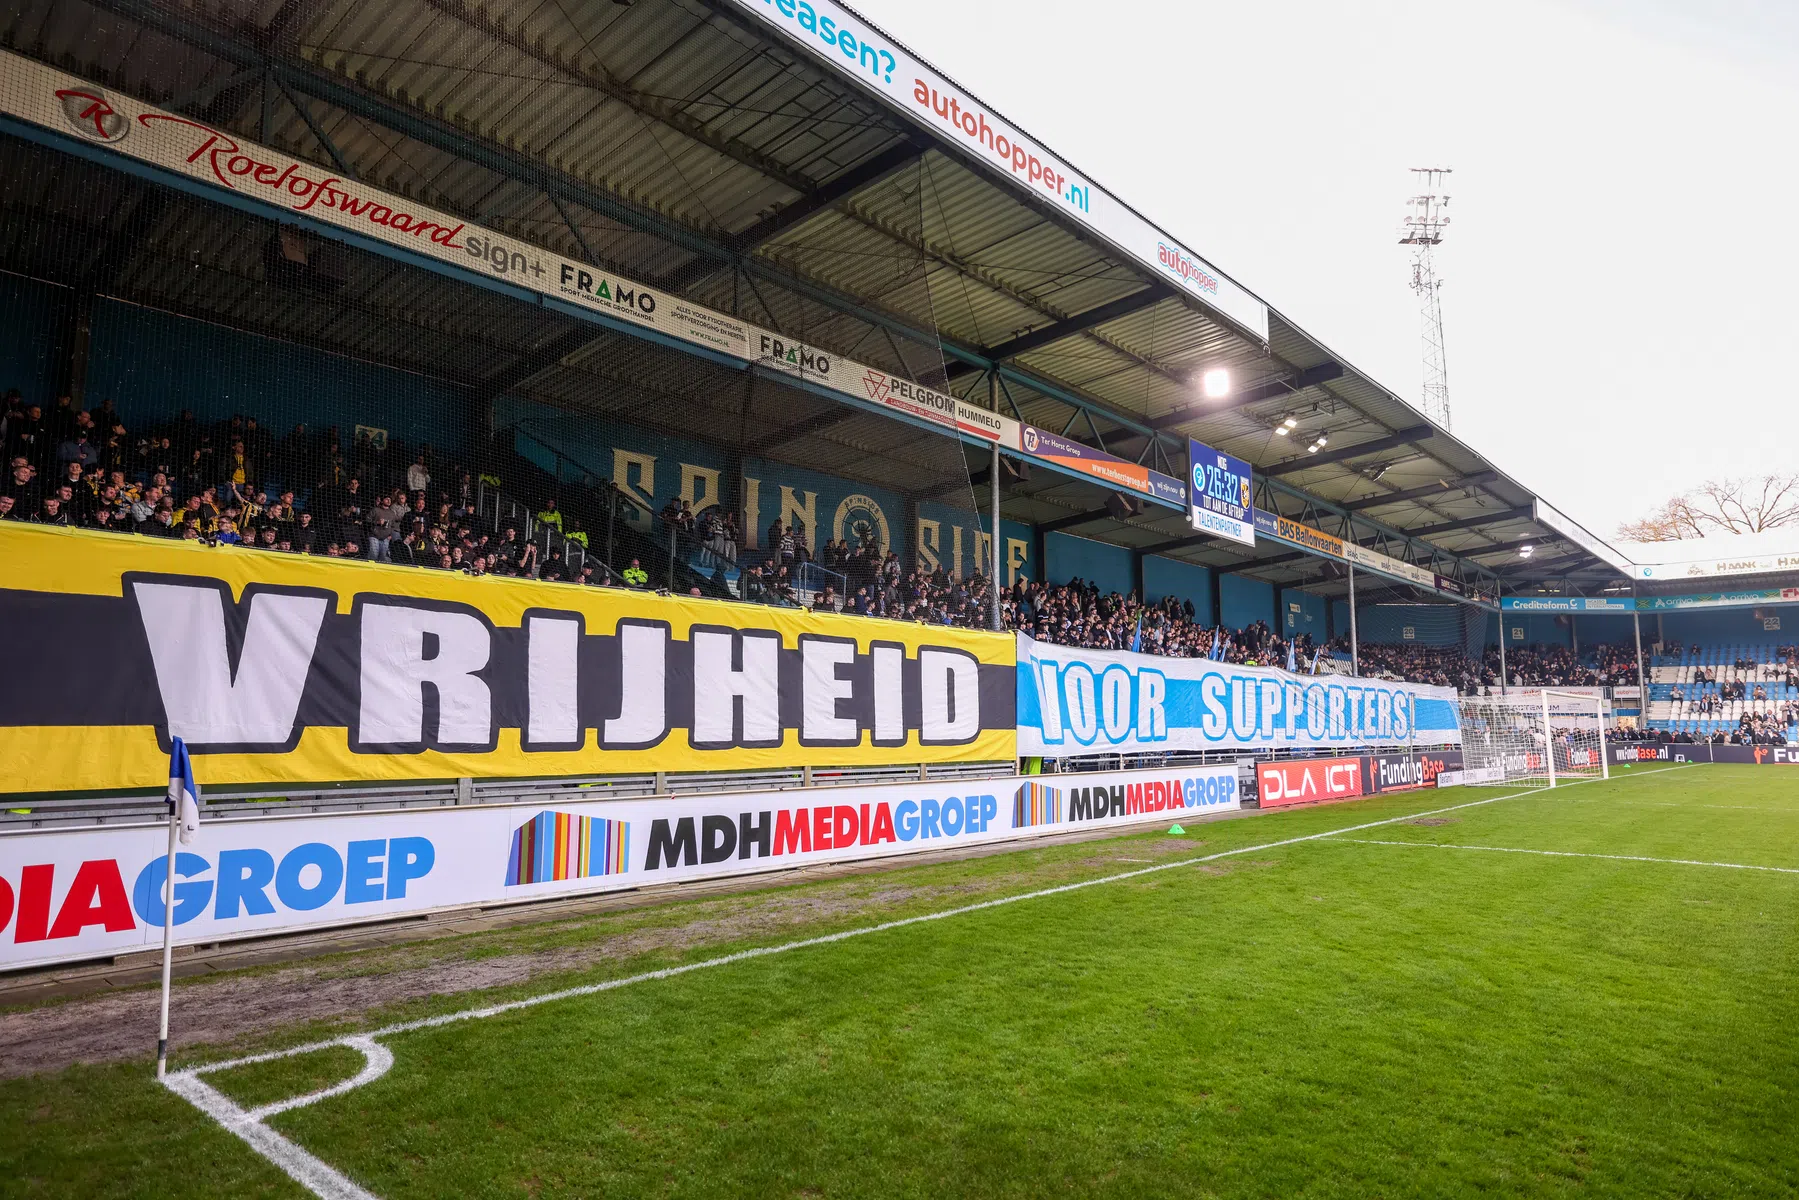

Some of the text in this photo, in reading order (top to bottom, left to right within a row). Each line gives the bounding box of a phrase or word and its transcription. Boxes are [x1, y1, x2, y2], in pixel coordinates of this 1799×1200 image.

[764, 0, 896, 84] easen?
[913, 78, 1090, 214] autohopper.nl
[138, 113, 465, 249] Roelofswaard
[1159, 244, 1217, 293] autohopper
[560, 263, 656, 313] FRAMO
[560, 286, 655, 323] SPORT MEDISCHE GROOTHANDEL
[760, 335, 830, 373] FRAMO
[890, 378, 1002, 431] PELGROM HUMMELO
[1041, 436, 1081, 457] Ter Horst Groep
[1217, 455, 1228, 470] NOG
[1092, 463, 1147, 489] www.terhorstgroep.nl
[1207, 464, 1239, 505] 26:32
[1198, 511, 1242, 537] TALENTENPARTNER
[1203, 494, 1244, 520] TOT AAN DE AFTRAP
[1280, 519, 1342, 555] BAS Ballonvaarten
[1513, 600, 1569, 609] Creditreform
[1665, 598, 1694, 606] arriva
[1729, 593, 1760, 602] arriva
[1764, 618, 1779, 626] 22
[121, 570, 983, 754] VRIJHEID
[1201, 670, 1417, 742] SUPPORTERS!
[1379, 756, 1445, 786] FundingBase
[1773, 748, 1799, 762] Fu
[1263, 763, 1357, 801] DLA ICT
[0, 836, 436, 944] IAGROEP
